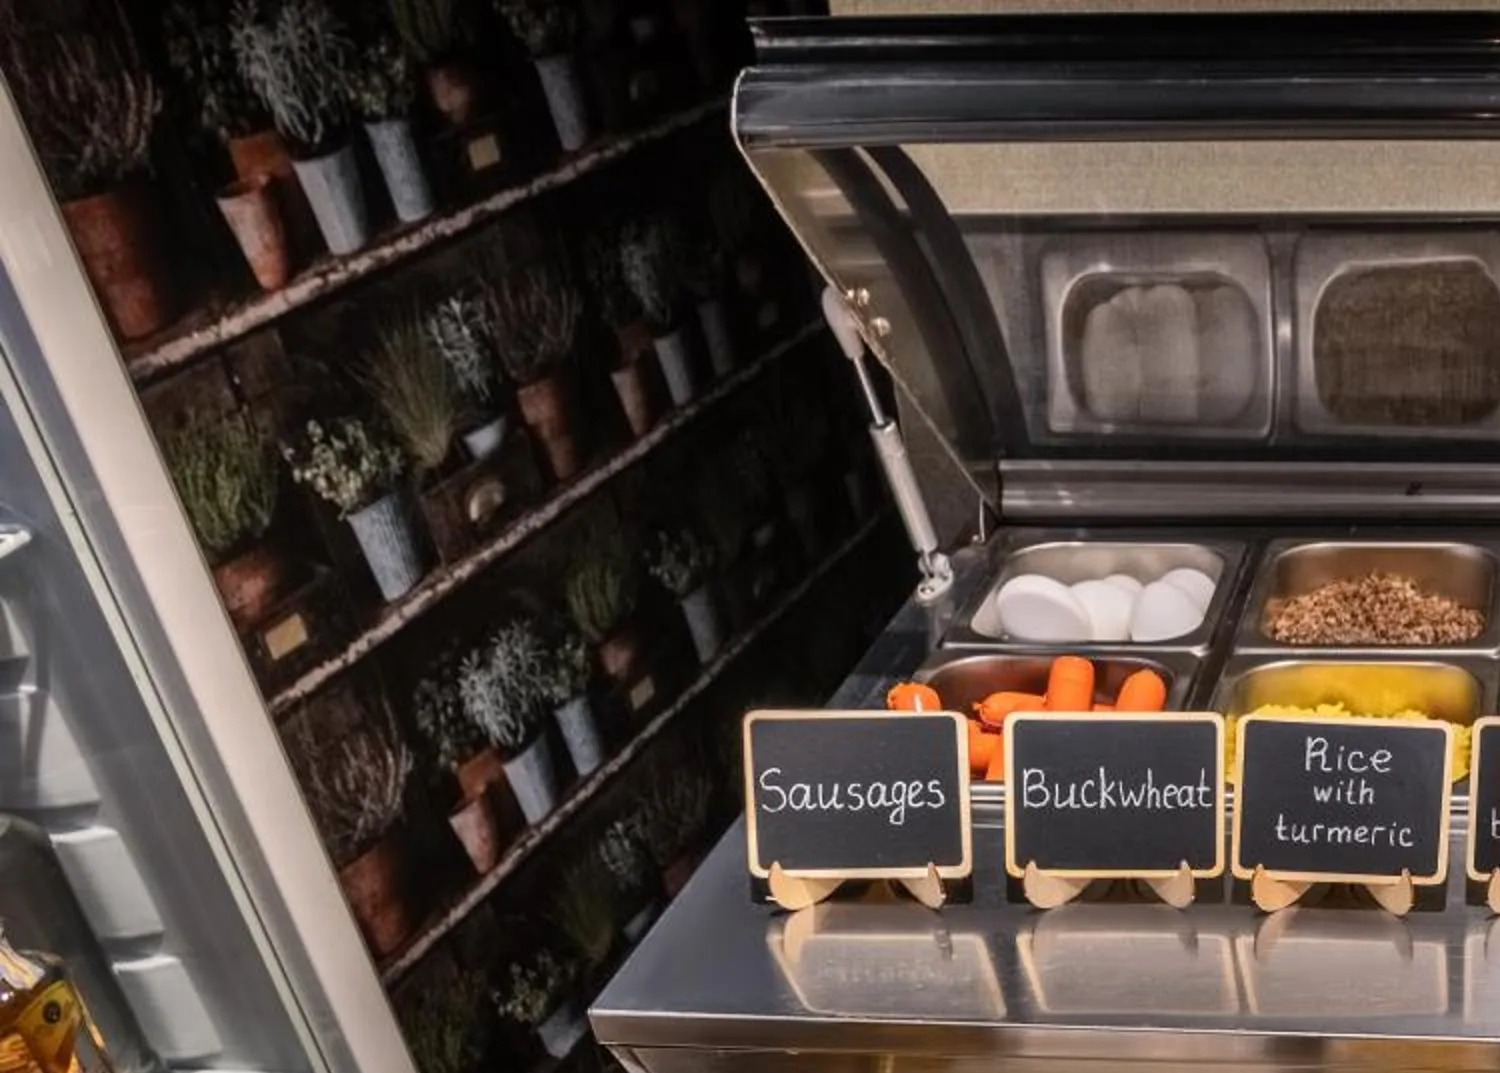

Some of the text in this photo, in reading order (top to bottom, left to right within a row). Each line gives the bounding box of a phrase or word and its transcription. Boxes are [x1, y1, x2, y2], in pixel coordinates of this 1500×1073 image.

[1304, 736, 1393, 773] Rice
[759, 767, 946, 826] Sausages
[1022, 766, 1213, 809] Buckwheat
[1313, 778, 1375, 805] with
[1274, 813, 1415, 848] turmeric
